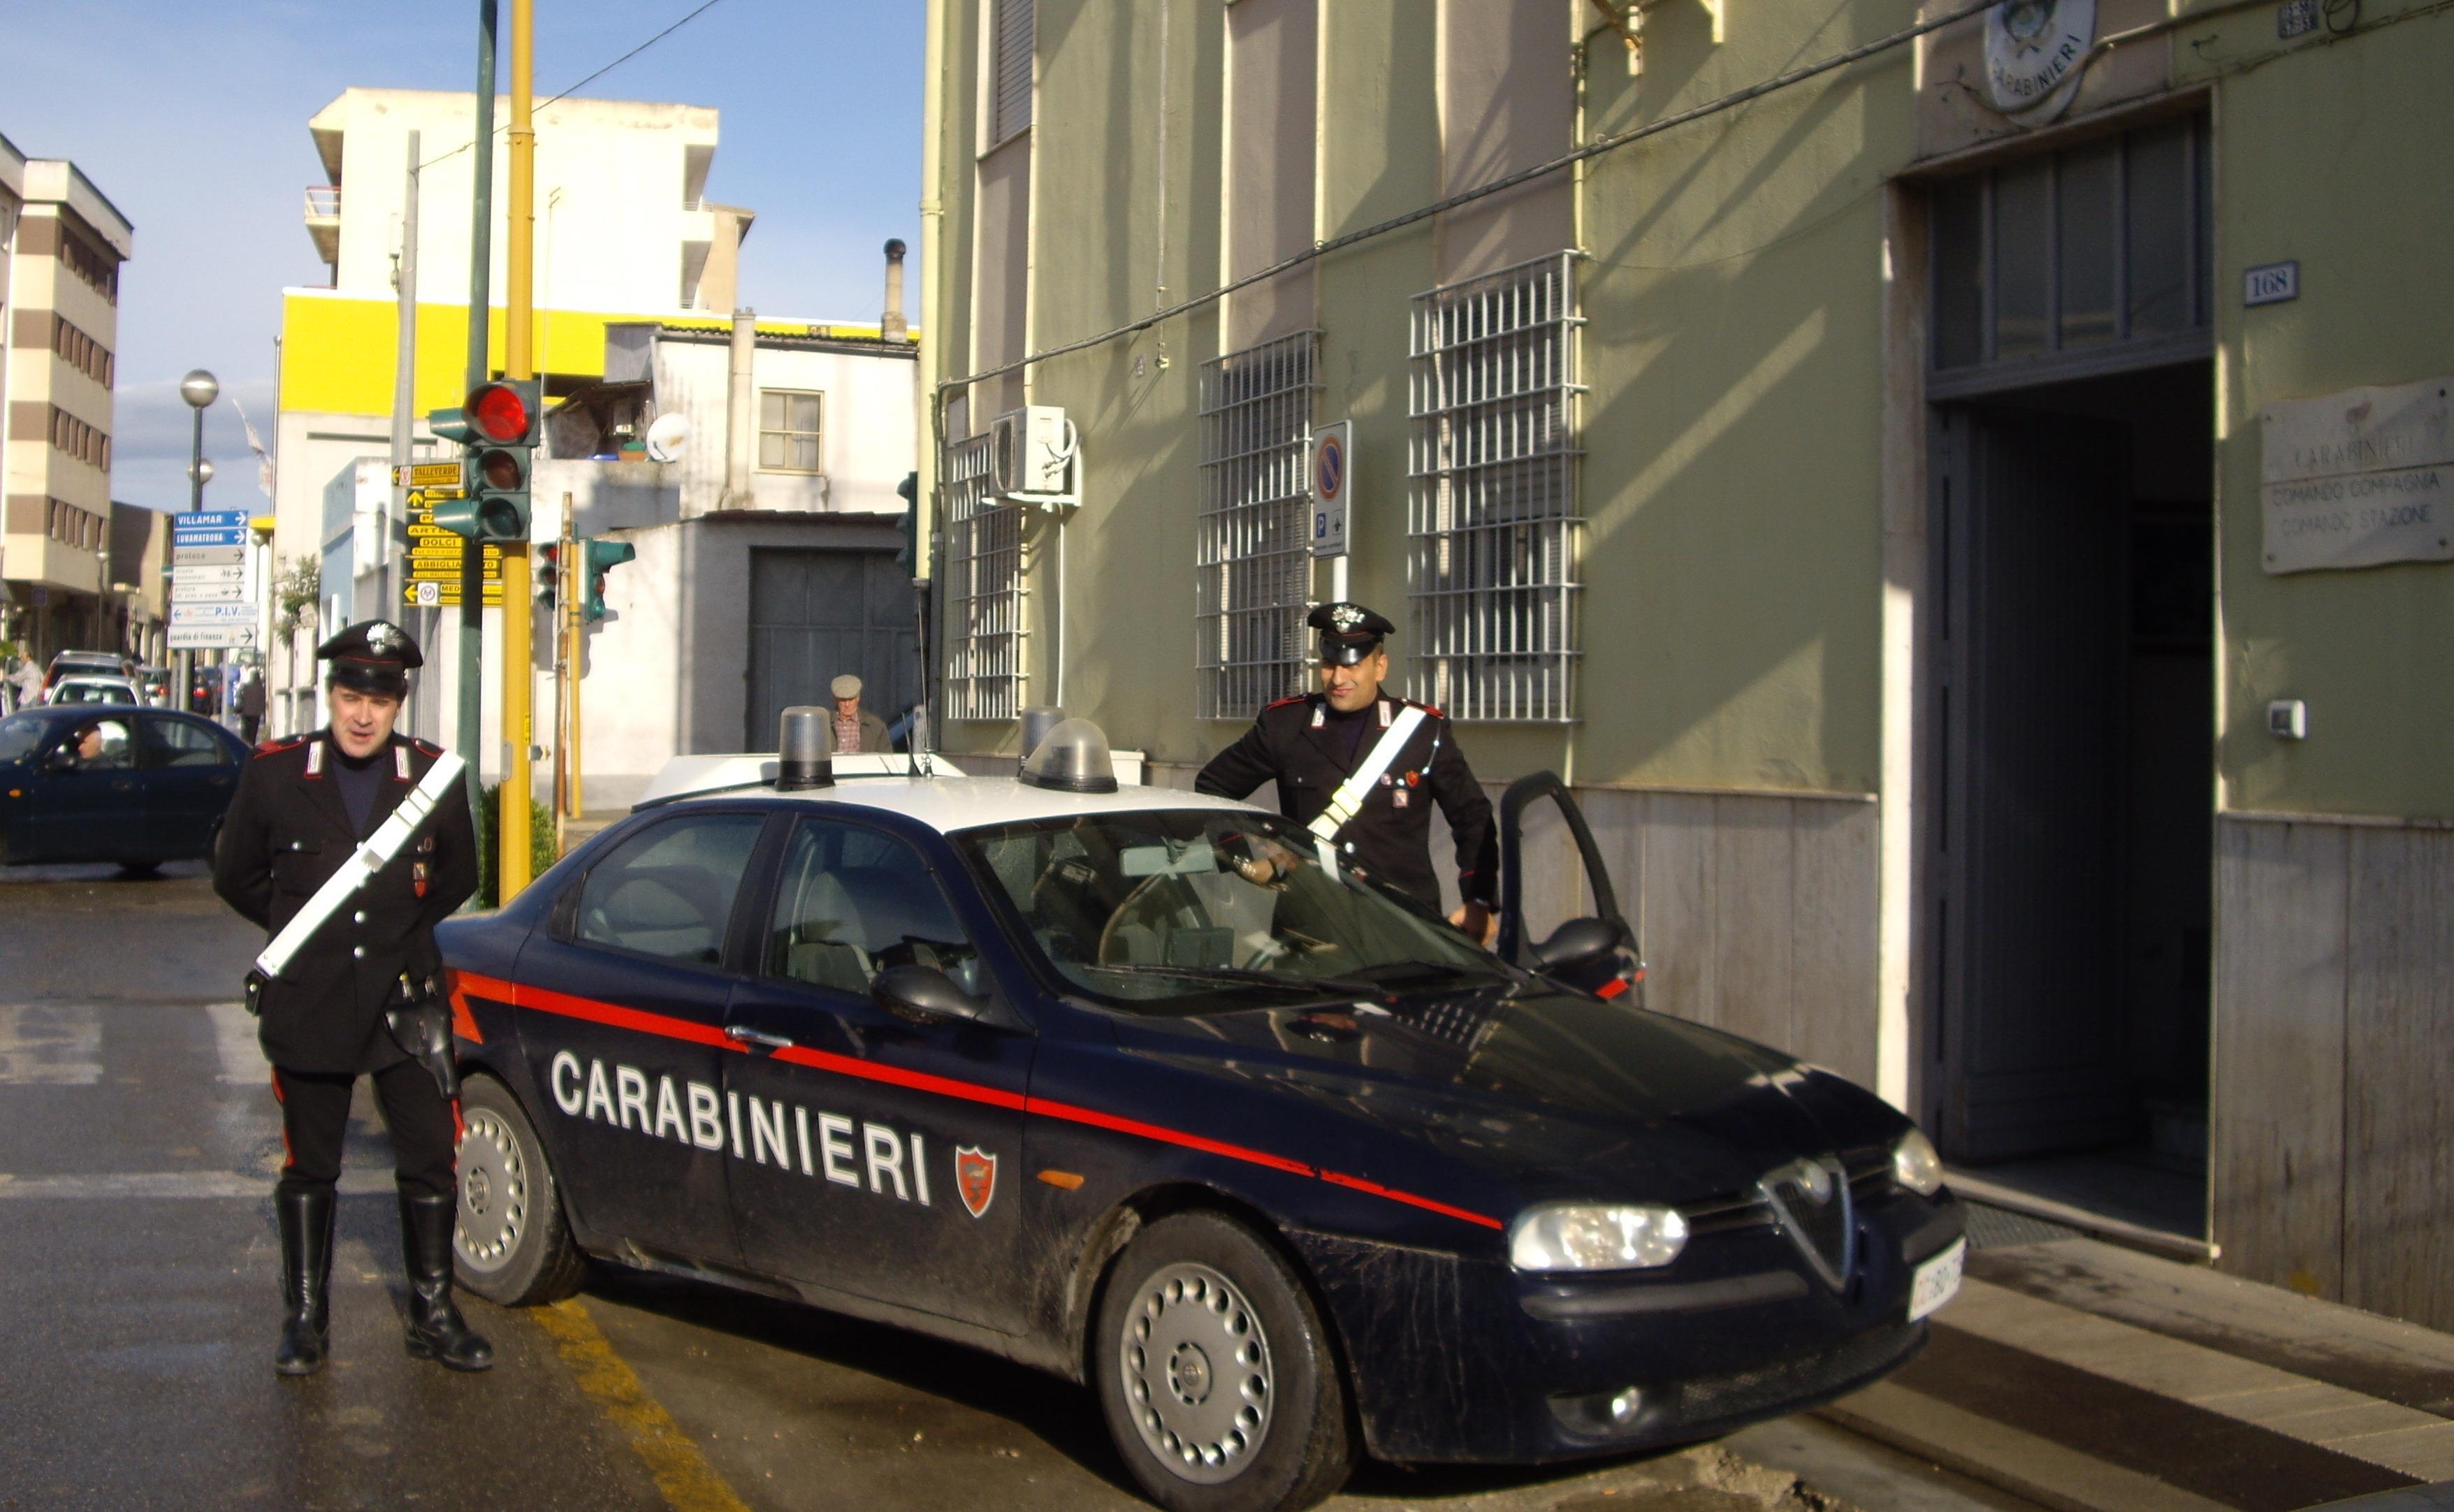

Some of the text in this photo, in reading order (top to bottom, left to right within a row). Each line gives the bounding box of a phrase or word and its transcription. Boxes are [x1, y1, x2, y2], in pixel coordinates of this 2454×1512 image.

[2253, 268, 2288, 296] 168
[414, 466, 457, 476] VALLEVERDE
[177, 515, 223, 525] VILLAMAR
[215, 606, 241, 616] P.I.V.
[550, 1049, 931, 1206] CARABINIERI
